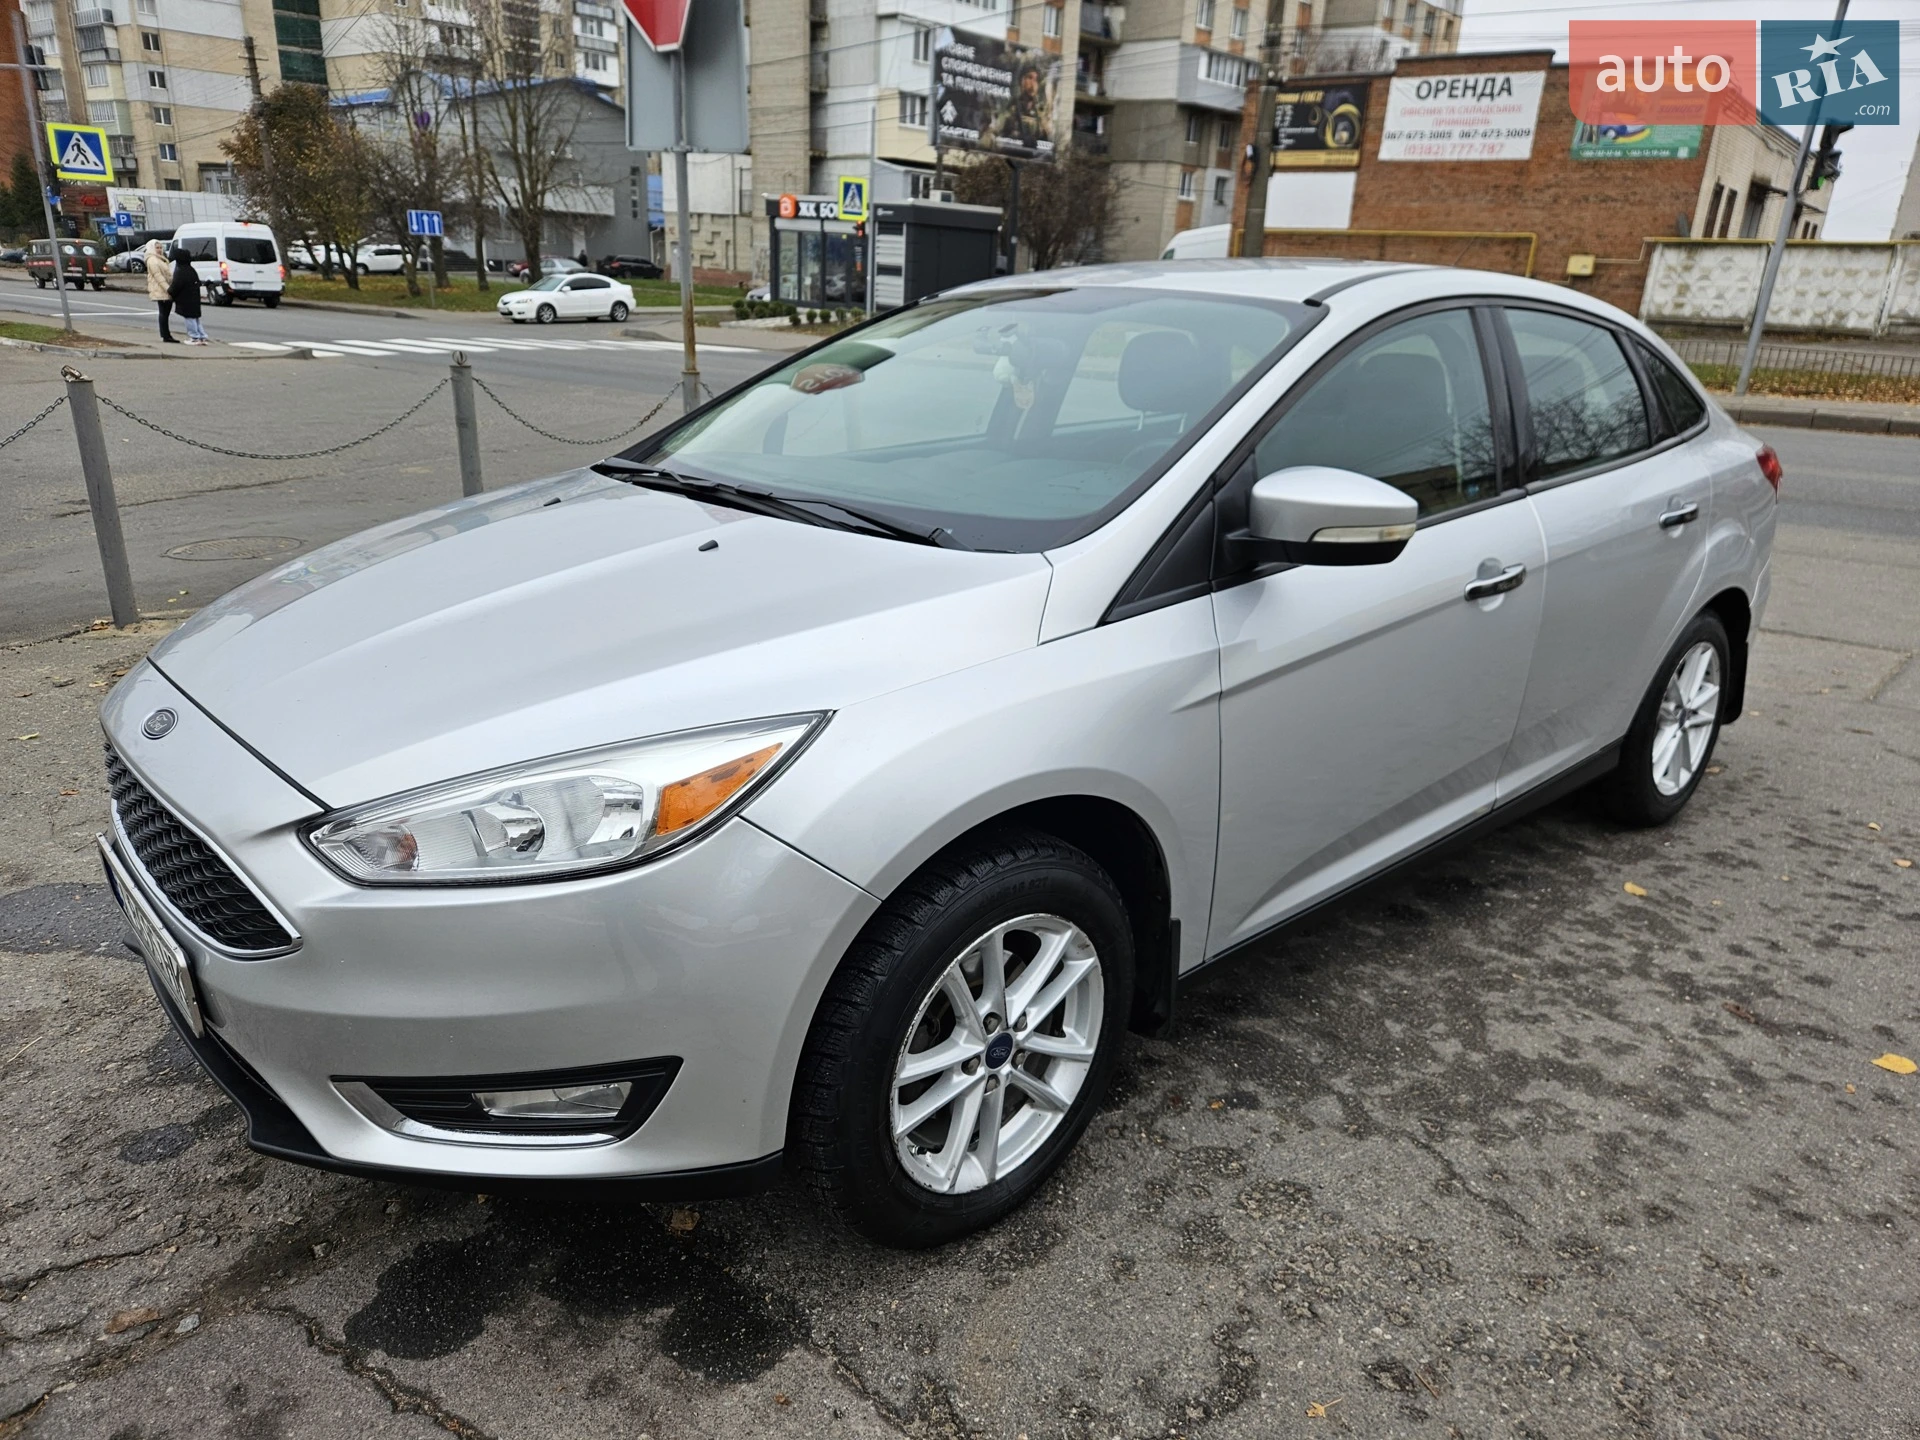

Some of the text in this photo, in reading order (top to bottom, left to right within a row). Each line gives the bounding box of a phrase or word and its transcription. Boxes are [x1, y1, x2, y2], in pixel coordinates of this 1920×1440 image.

[941, 72, 954, 88] ТА
[1415, 76, 1513, 102] ОРЕНДА
[1445, 106, 1456, 115] ТА
[1458, 103, 1523, 115] СКЛАДСЬКИХ
[798, 202, 818, 217] ЖК
